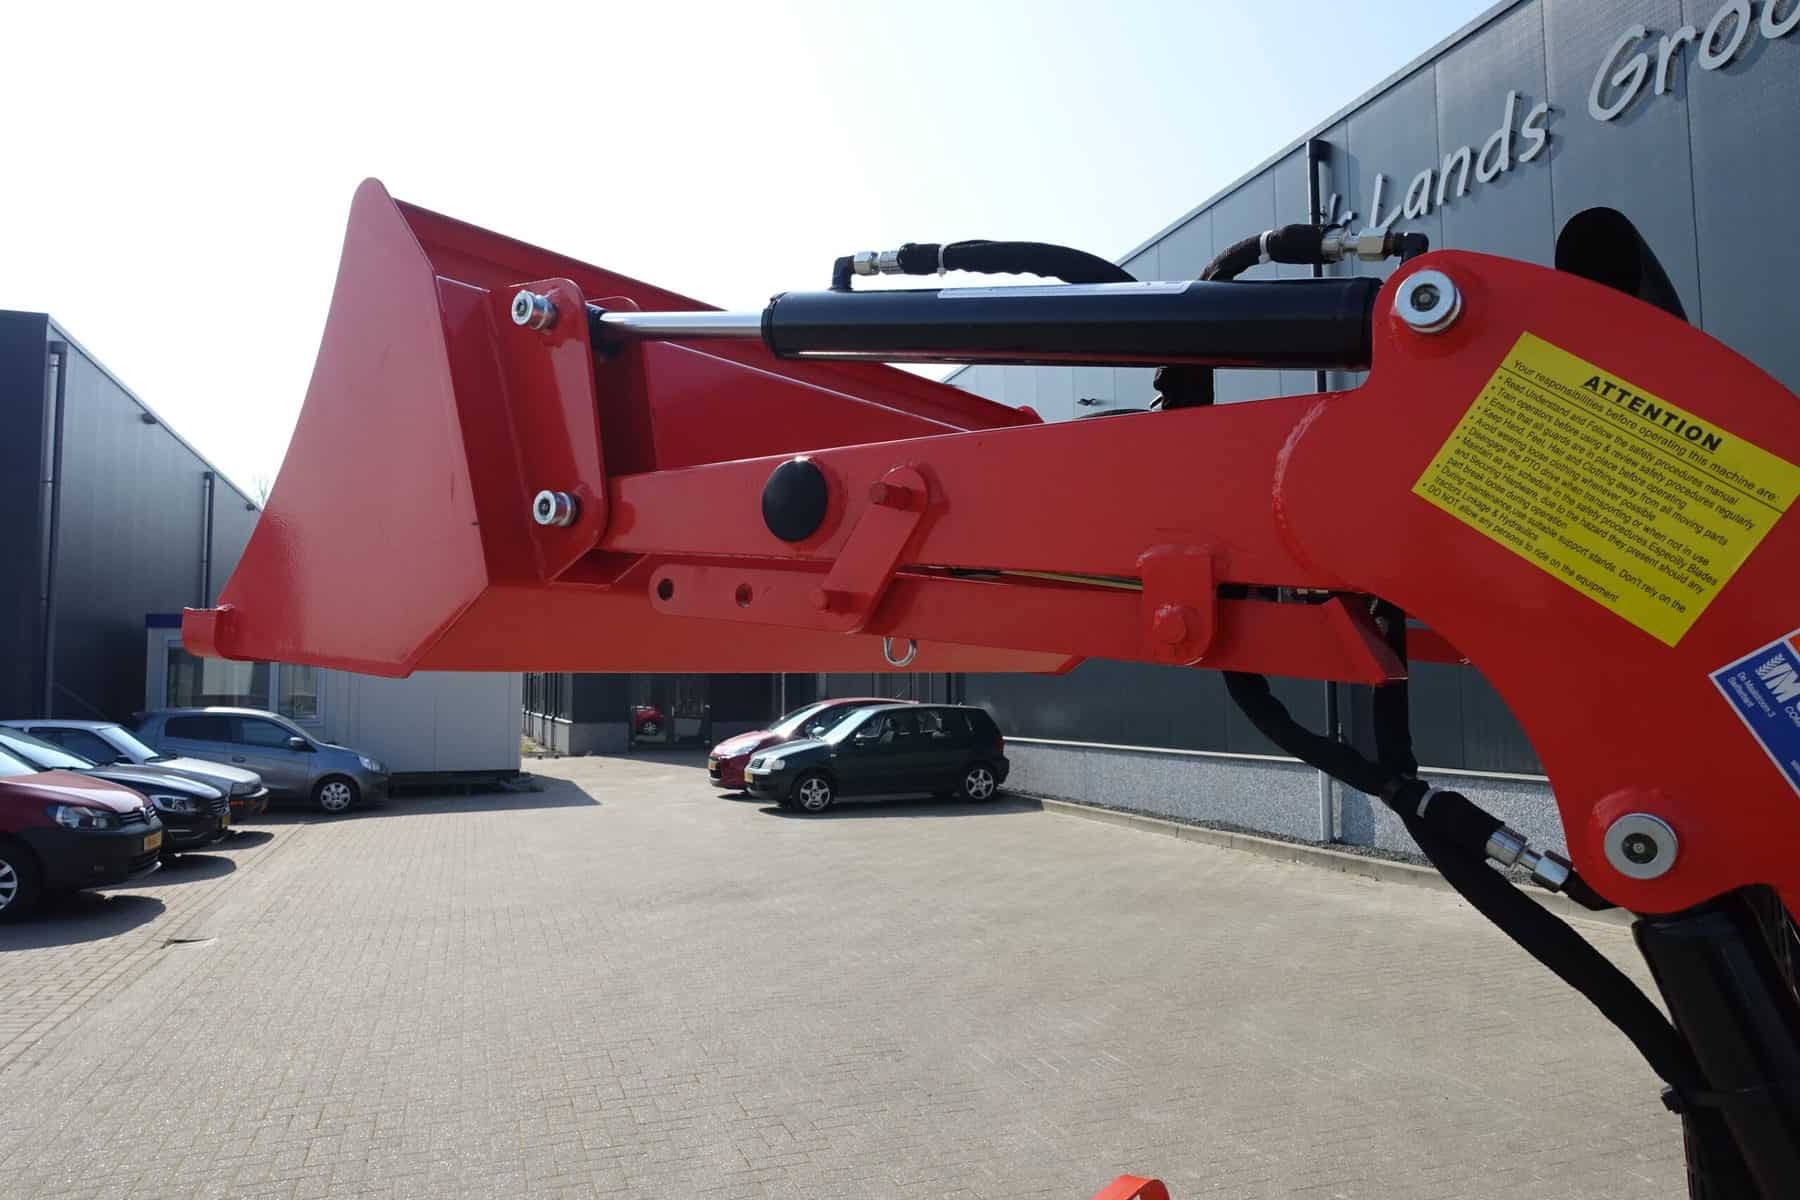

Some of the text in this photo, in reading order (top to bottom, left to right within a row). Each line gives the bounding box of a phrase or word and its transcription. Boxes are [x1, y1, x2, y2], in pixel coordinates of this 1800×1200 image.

[1369, 90, 1549, 229] Lands
[1475, 417, 1498, 433] Avoid
[1527, 445, 1550, 462] loose
[1549, 459, 1581, 482] clothing
[1581, 477, 1621, 502] whenever
[1619, 499, 1656, 521] possible
[1489, 397, 1687, 510] Ensure that all guards are in place before operating
[1497, 388, 1754, 531] Train operators before using & review safety procedures regularly
[1512, 361, 1534, 376] Your
[1534, 373, 1604, 412] responsibilities
[1605, 408, 1637, 429] before
[1638, 427, 1687, 457] operating
[1688, 450, 1708, 466] this
[1709, 464, 1755, 490] machine
[1524, 388, 1570, 416] Understand
[1569, 414, 1587, 425] and
[1586, 421, 1613, 439] Follow
[1613, 435, 1628, 447] the
[1628, 445, 1654, 463] safety
[1653, 459, 1704, 487] procedures
[1704, 485, 1740, 505] manual
[1585, 375, 1722, 450] ATTENTION
[1427, 484, 1620, 602] DO NOT allow any persons to ride on the equipment
[1441, 466, 1466, 486] During
[1527, 517, 1558, 538] suitable
[1558, 536, 1590, 556] support
[1618, 569, 1643, 587] Don't
[1641, 584, 1658, 598] rely
[1658, 594, 1671, 603] on
[1671, 599, 1687, 613] the
[1446, 458, 1568, 529] part break loose during operation
[1454, 448, 1471, 459] and
[1469, 455, 1501, 479] Securing
[1540, 495, 1557, 509] due
[1556, 504, 1566, 514] to
[1565, 509, 1579, 522] the
[1579, 517, 1609, 538] hazard
[1608, 533, 1627, 551] they
[1625, 546, 1660, 567] present
[1658, 564, 1689, 583] should
[1687, 581, 1704, 595] any
[1491, 509, 1500, 517] &
[1493, 456, 1503, 464] as
[1502, 462, 1518, 473] per
[1517, 470, 1552, 492] schedule
[1552, 487, 1562, 497] in
[1561, 493, 1576, 505] the
[1576, 503, 1601, 521] safety
[1600, 517, 1648, 546] procedures
[1687, 564, 1718, 585] Blades
[1508, 449, 1521, 461] the
[1521, 456, 1541, 471] PTO
[1540, 467, 1561, 483] drive
[1561, 480, 1584, 495] when
[1583, 490, 1632, 524] transporting
[1632, 519, 1642, 528] or
[1643, 526, 1667, 542] when
[1667, 539, 1685, 551] not
[1682, 545, 1693, 556] in
[1692, 553, 1710, 565] use
[1548, 443, 1565, 457] Hair
[1565, 454, 1583, 466] and
[1582, 462, 1616, 486] Clothing
[1616, 481, 1638, 498] away
[1639, 492, 1659, 508] from
[1660, 506, 1674, 515] all
[1672, 512, 1704, 534] moving
[1703, 530, 1728, 545] parts
